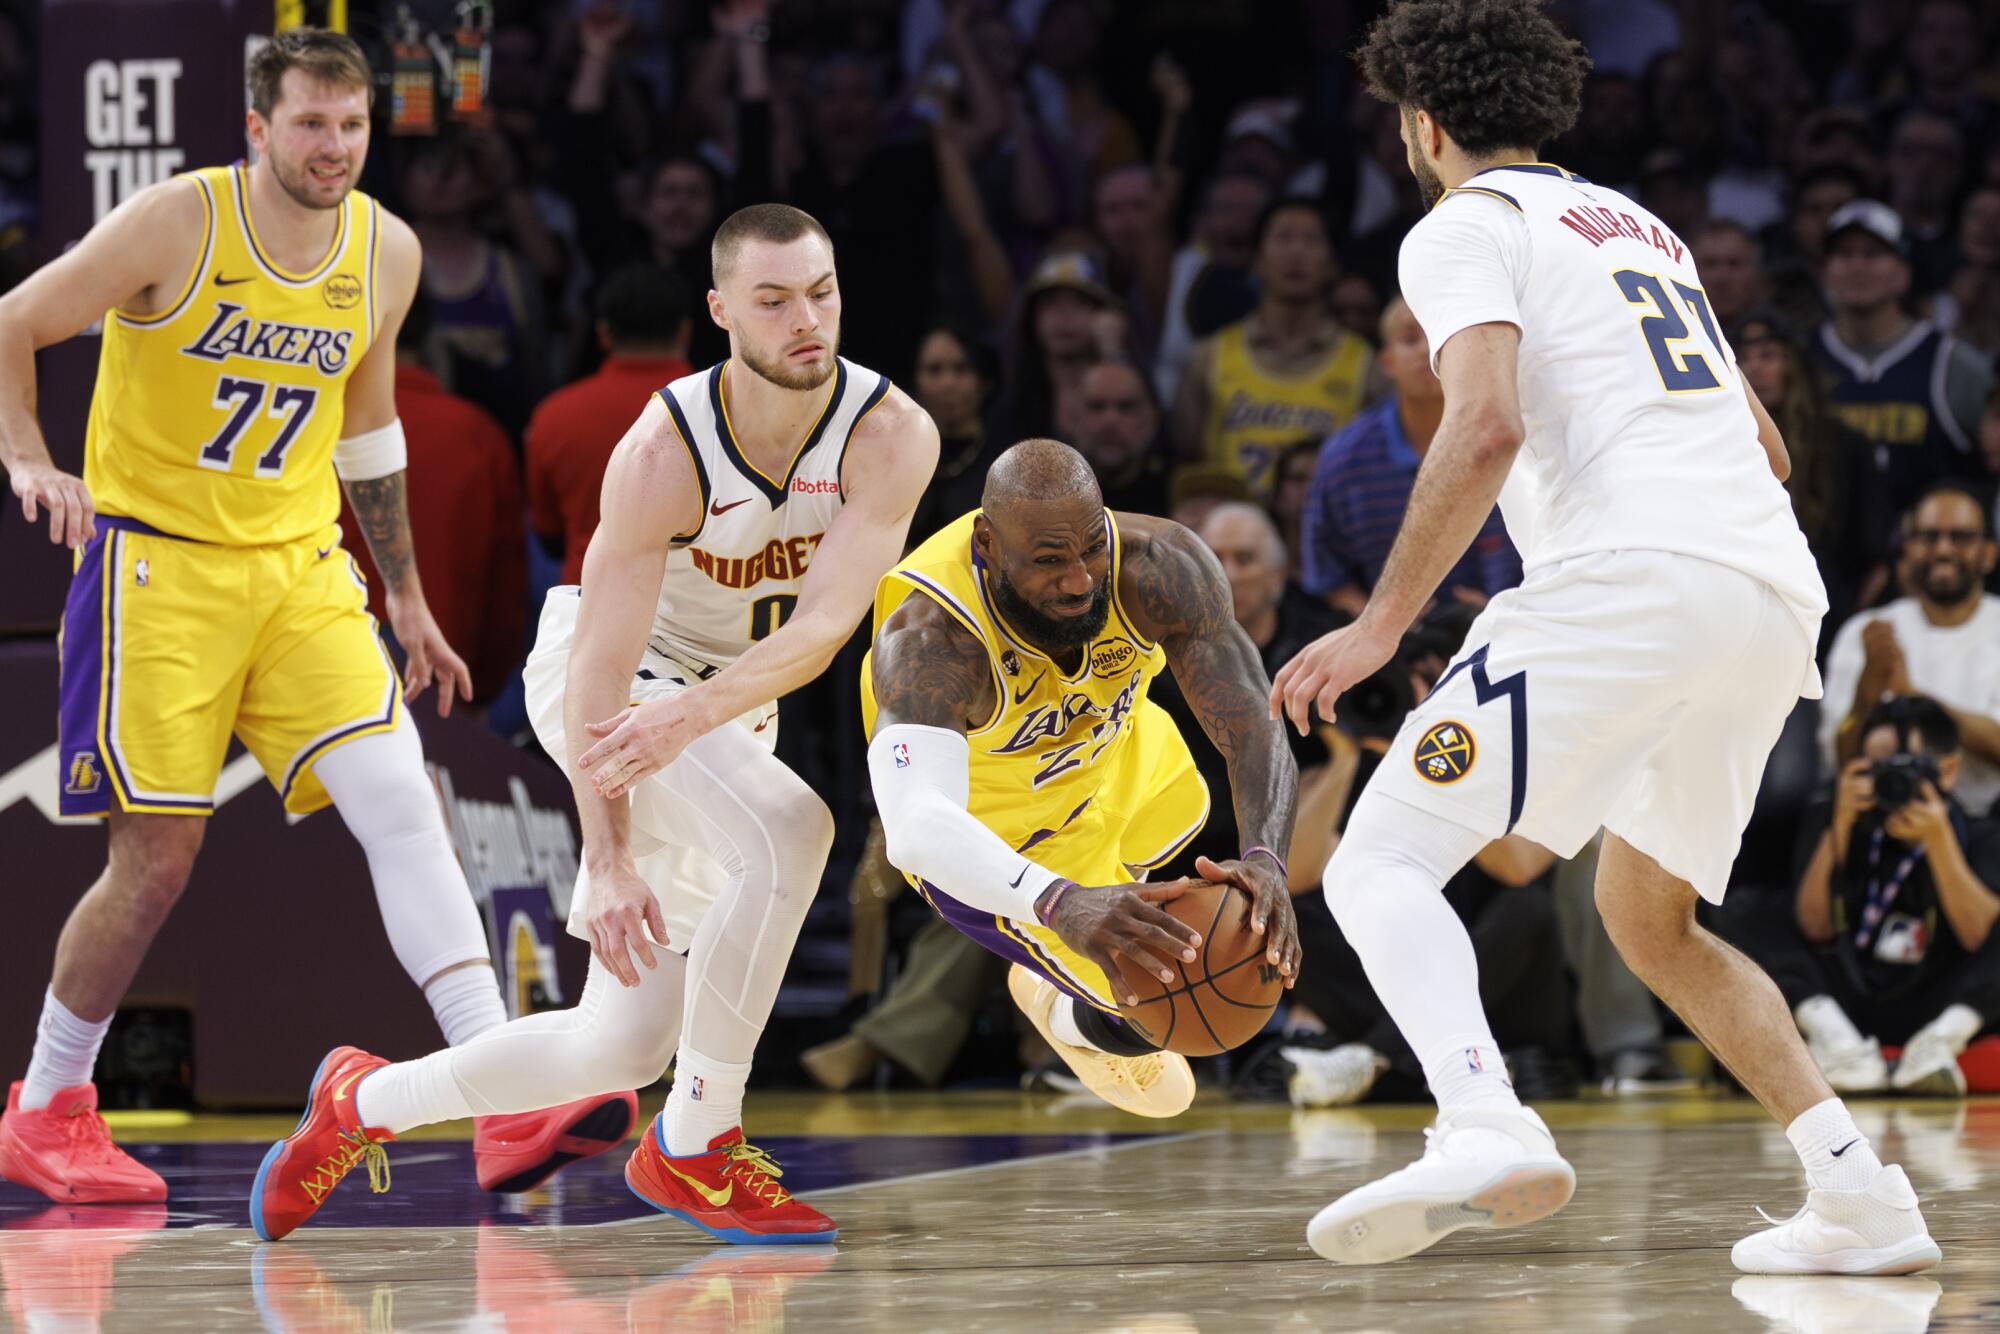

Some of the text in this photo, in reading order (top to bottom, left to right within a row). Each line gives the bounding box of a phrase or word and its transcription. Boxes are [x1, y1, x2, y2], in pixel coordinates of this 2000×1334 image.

[85, 58, 183, 148] GET
[1558, 205, 1684, 265] MURRAY
[178, 302, 354, 377] LAKERS
[1609, 266, 1734, 394] 27
[197, 374, 320, 480] 77
[791, 476, 839, 494] ibotta
[1091, 646, 1133, 669] bibigo
[987, 668, 1141, 754] LAKRS
